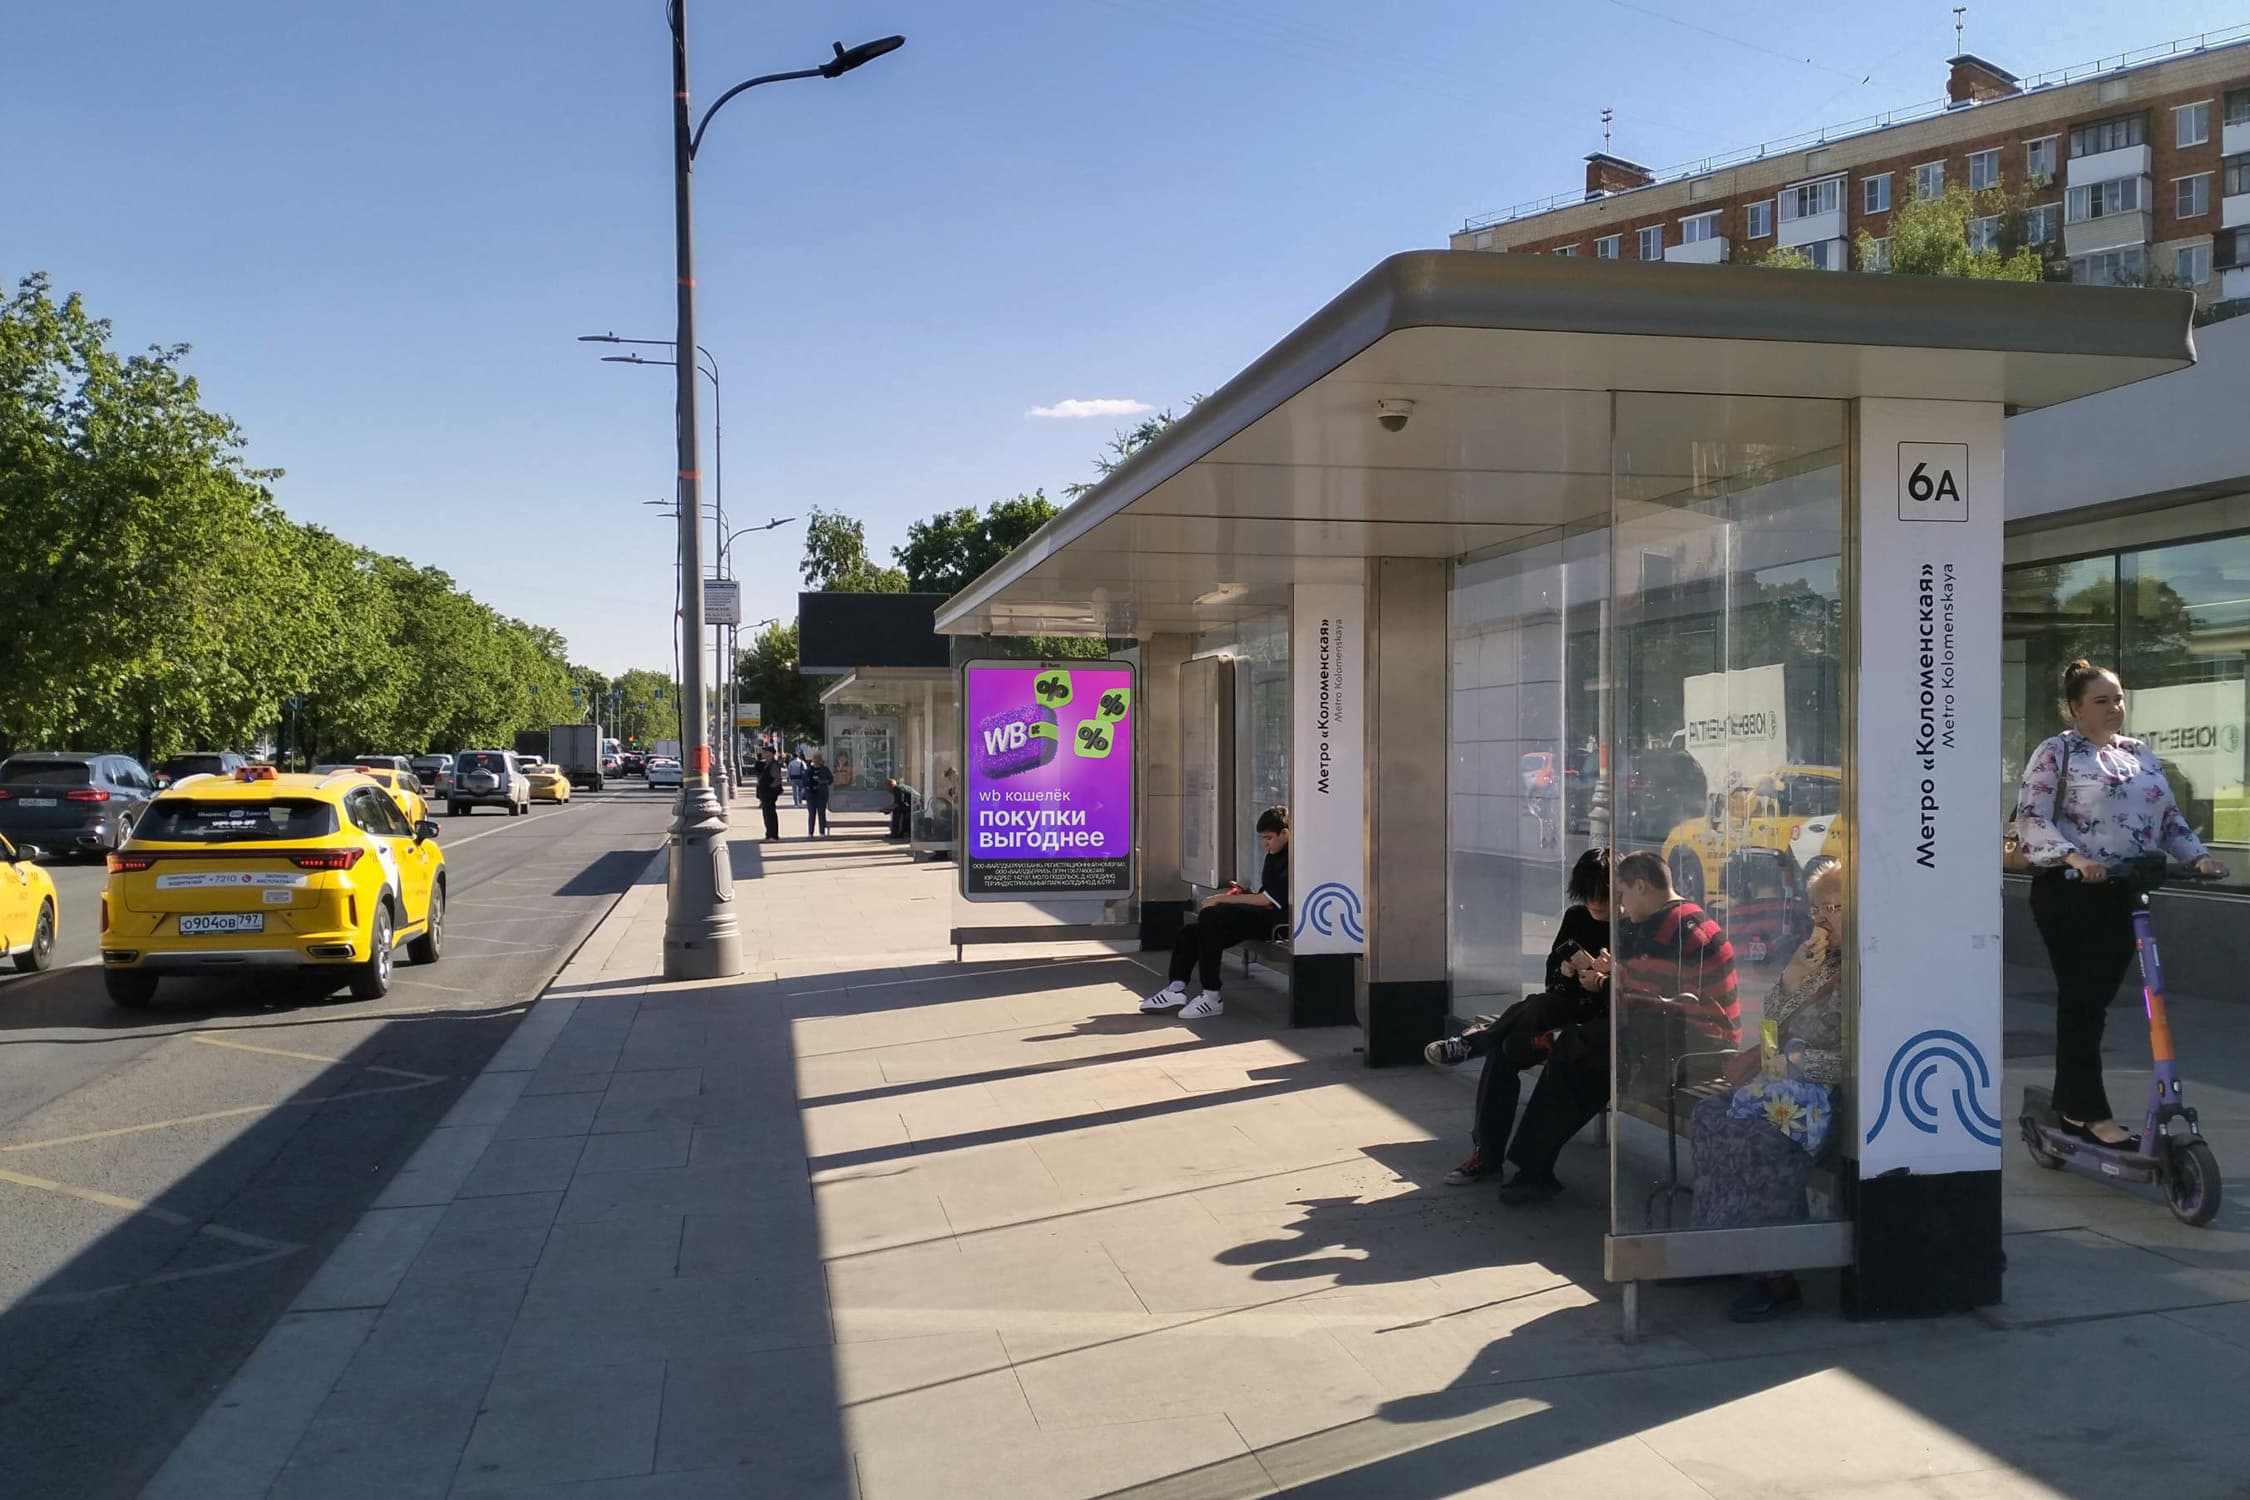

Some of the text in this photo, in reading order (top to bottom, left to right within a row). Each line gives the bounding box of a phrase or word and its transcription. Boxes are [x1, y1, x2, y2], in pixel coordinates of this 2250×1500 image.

[1908, 462, 1960, 502] 6А
[1334, 618, 1344, 723] Metro Kolomenskaya
[1940, 563, 1957, 749] Metro Kolomenskaya
[1317, 618, 1331, 795] Метро «Коломенская»
[1916, 563, 1939, 869] Метро «Коломенская»
[983, 721, 1027, 755] WB
[979, 788, 1071, 802] wb кошелёк
[979, 810, 1086, 831] покупки
[979, 831, 1105, 851] выгоднее
[184, 914, 259, 930] О904ОВ 797
